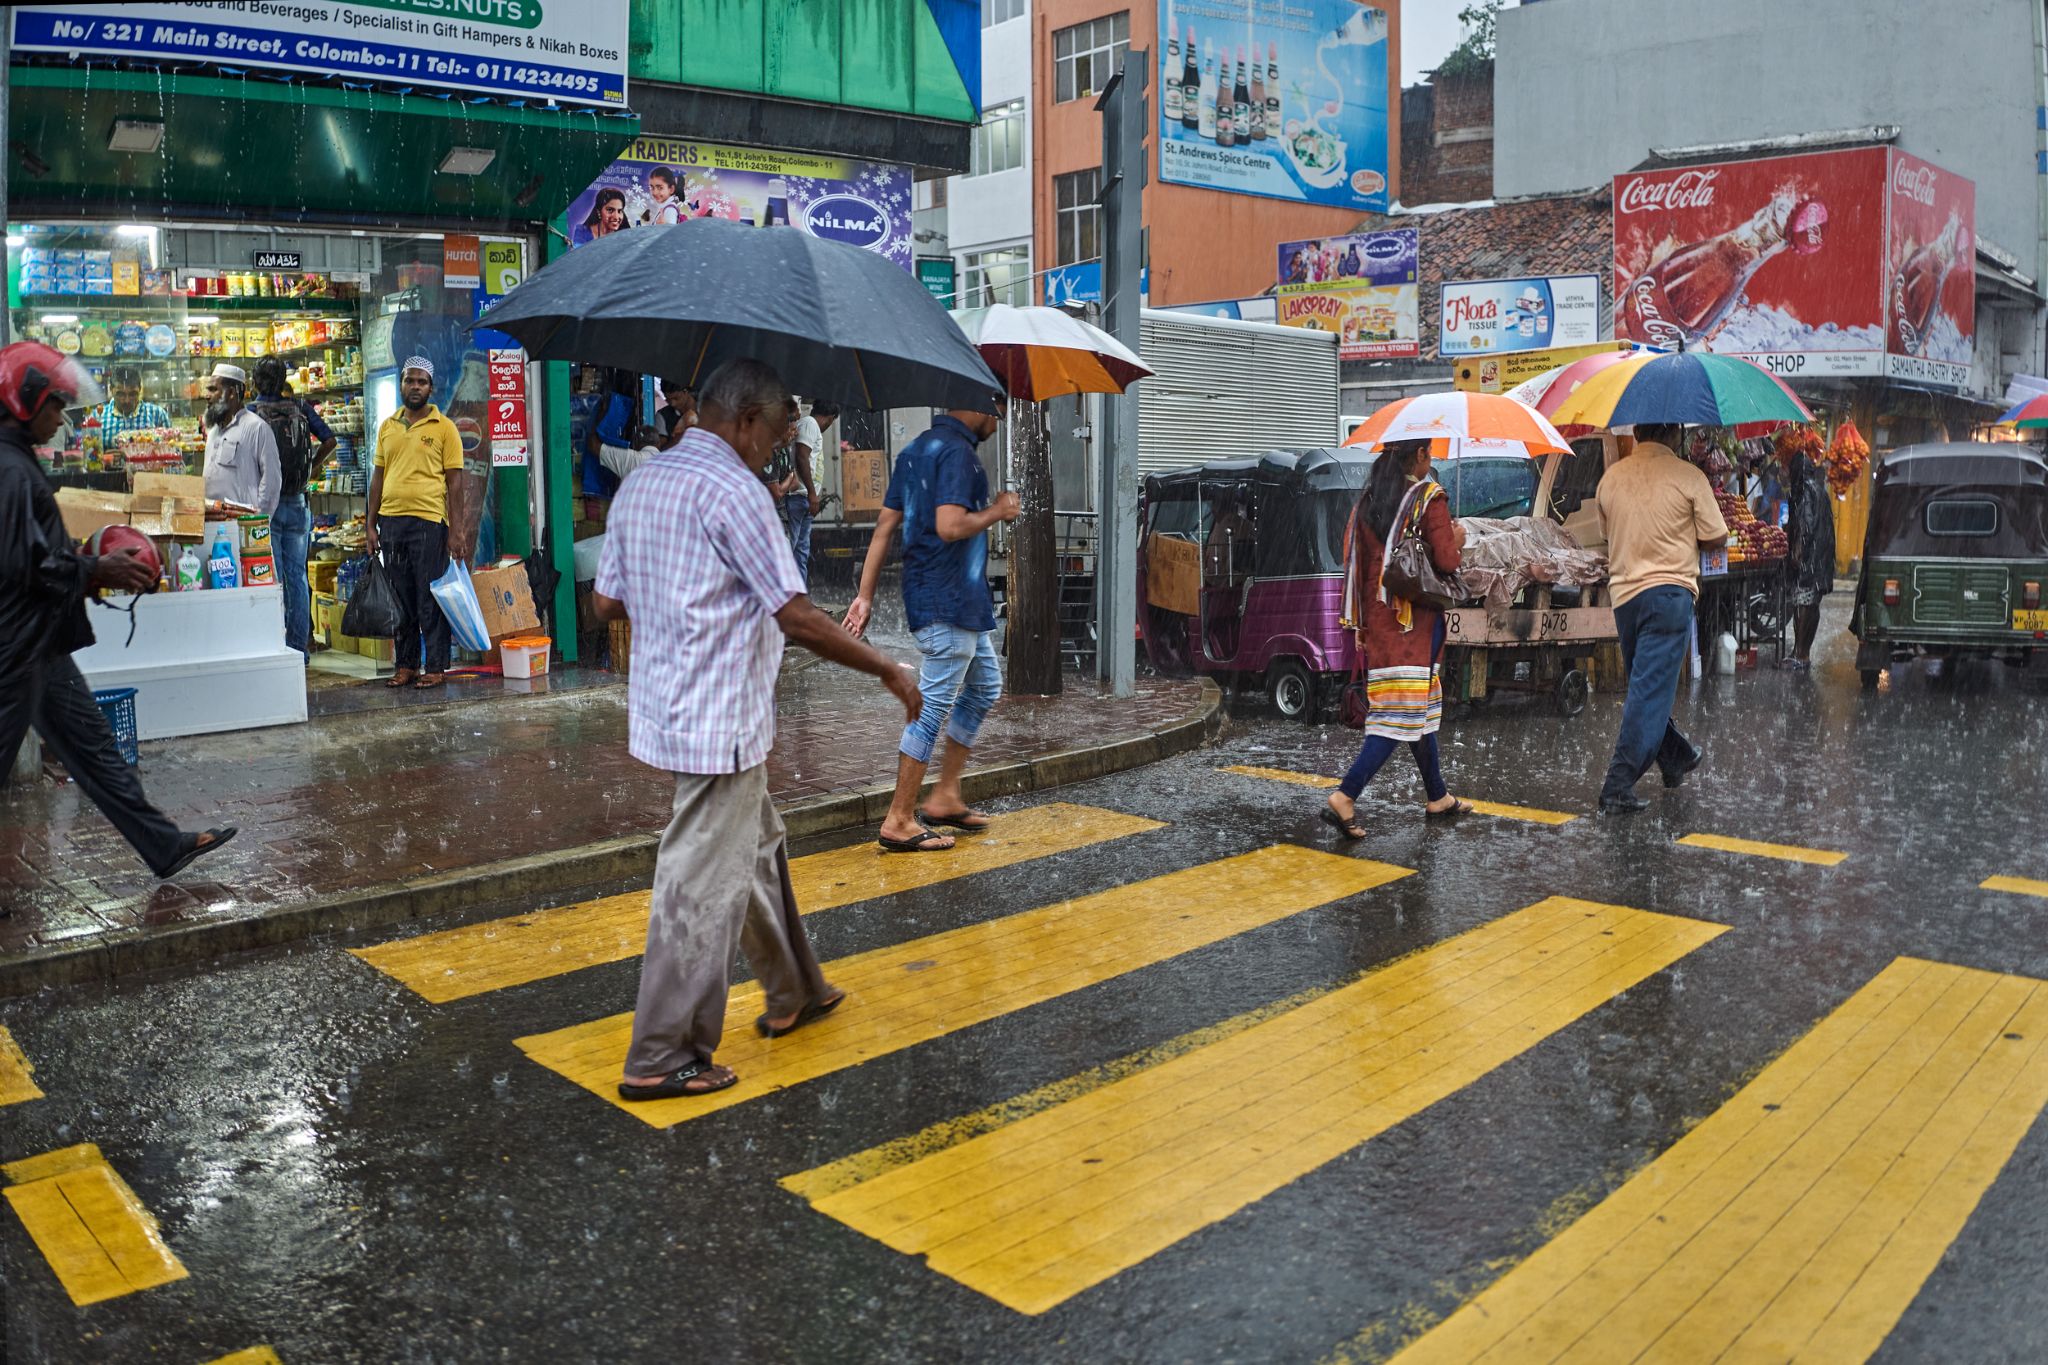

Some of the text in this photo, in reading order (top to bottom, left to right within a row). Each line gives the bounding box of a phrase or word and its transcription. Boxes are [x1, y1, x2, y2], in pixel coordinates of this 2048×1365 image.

[217, 1, 246, 12] and
[249, 2, 328, 22] Beverages
[343, 9, 413, 33] Specialist
[416, 19, 429, 34] in
[433, 22, 458, 39] Gift
[462, 26, 522, 48] Hampers
[526, 36, 535, 49] &
[540, 37, 576, 55] Nikah
[580, 44, 619, 61] Boxes
[52, 20, 599, 93] No/ 321 Main Street, Colombo-11 Tel:- 0114234495
[628, 140, 698, 164] TRADERS
[744, 152, 767, 162] John's
[1165, 142, 1271, 170] St. Andrews Spice Centre
[715, 159, 729, 167] TEL
[735, 162, 781, 172] 011-2439261
[1620, 169, 1721, 214] Coca-Cola
[1893, 157, 1937, 207] Coca-Cola
[1283, 296, 1342, 321] LAKSPRAY
[1446, 295, 1498, 332] Flora
[499, 351, 521, 360] Dialog
[1387, 343, 1415, 352] STORES
[1766, 355, 1805, 373] SHOP
[1891, 356, 1925, 377] SAMANTHA
[1927, 361, 1950, 381] PASTRY
[1951, 366, 1967, 385] SHOP
[494, 421, 521, 432] airtel
[493, 453, 523, 463] Dialog
[1552, 612, 1568, 632] 78
